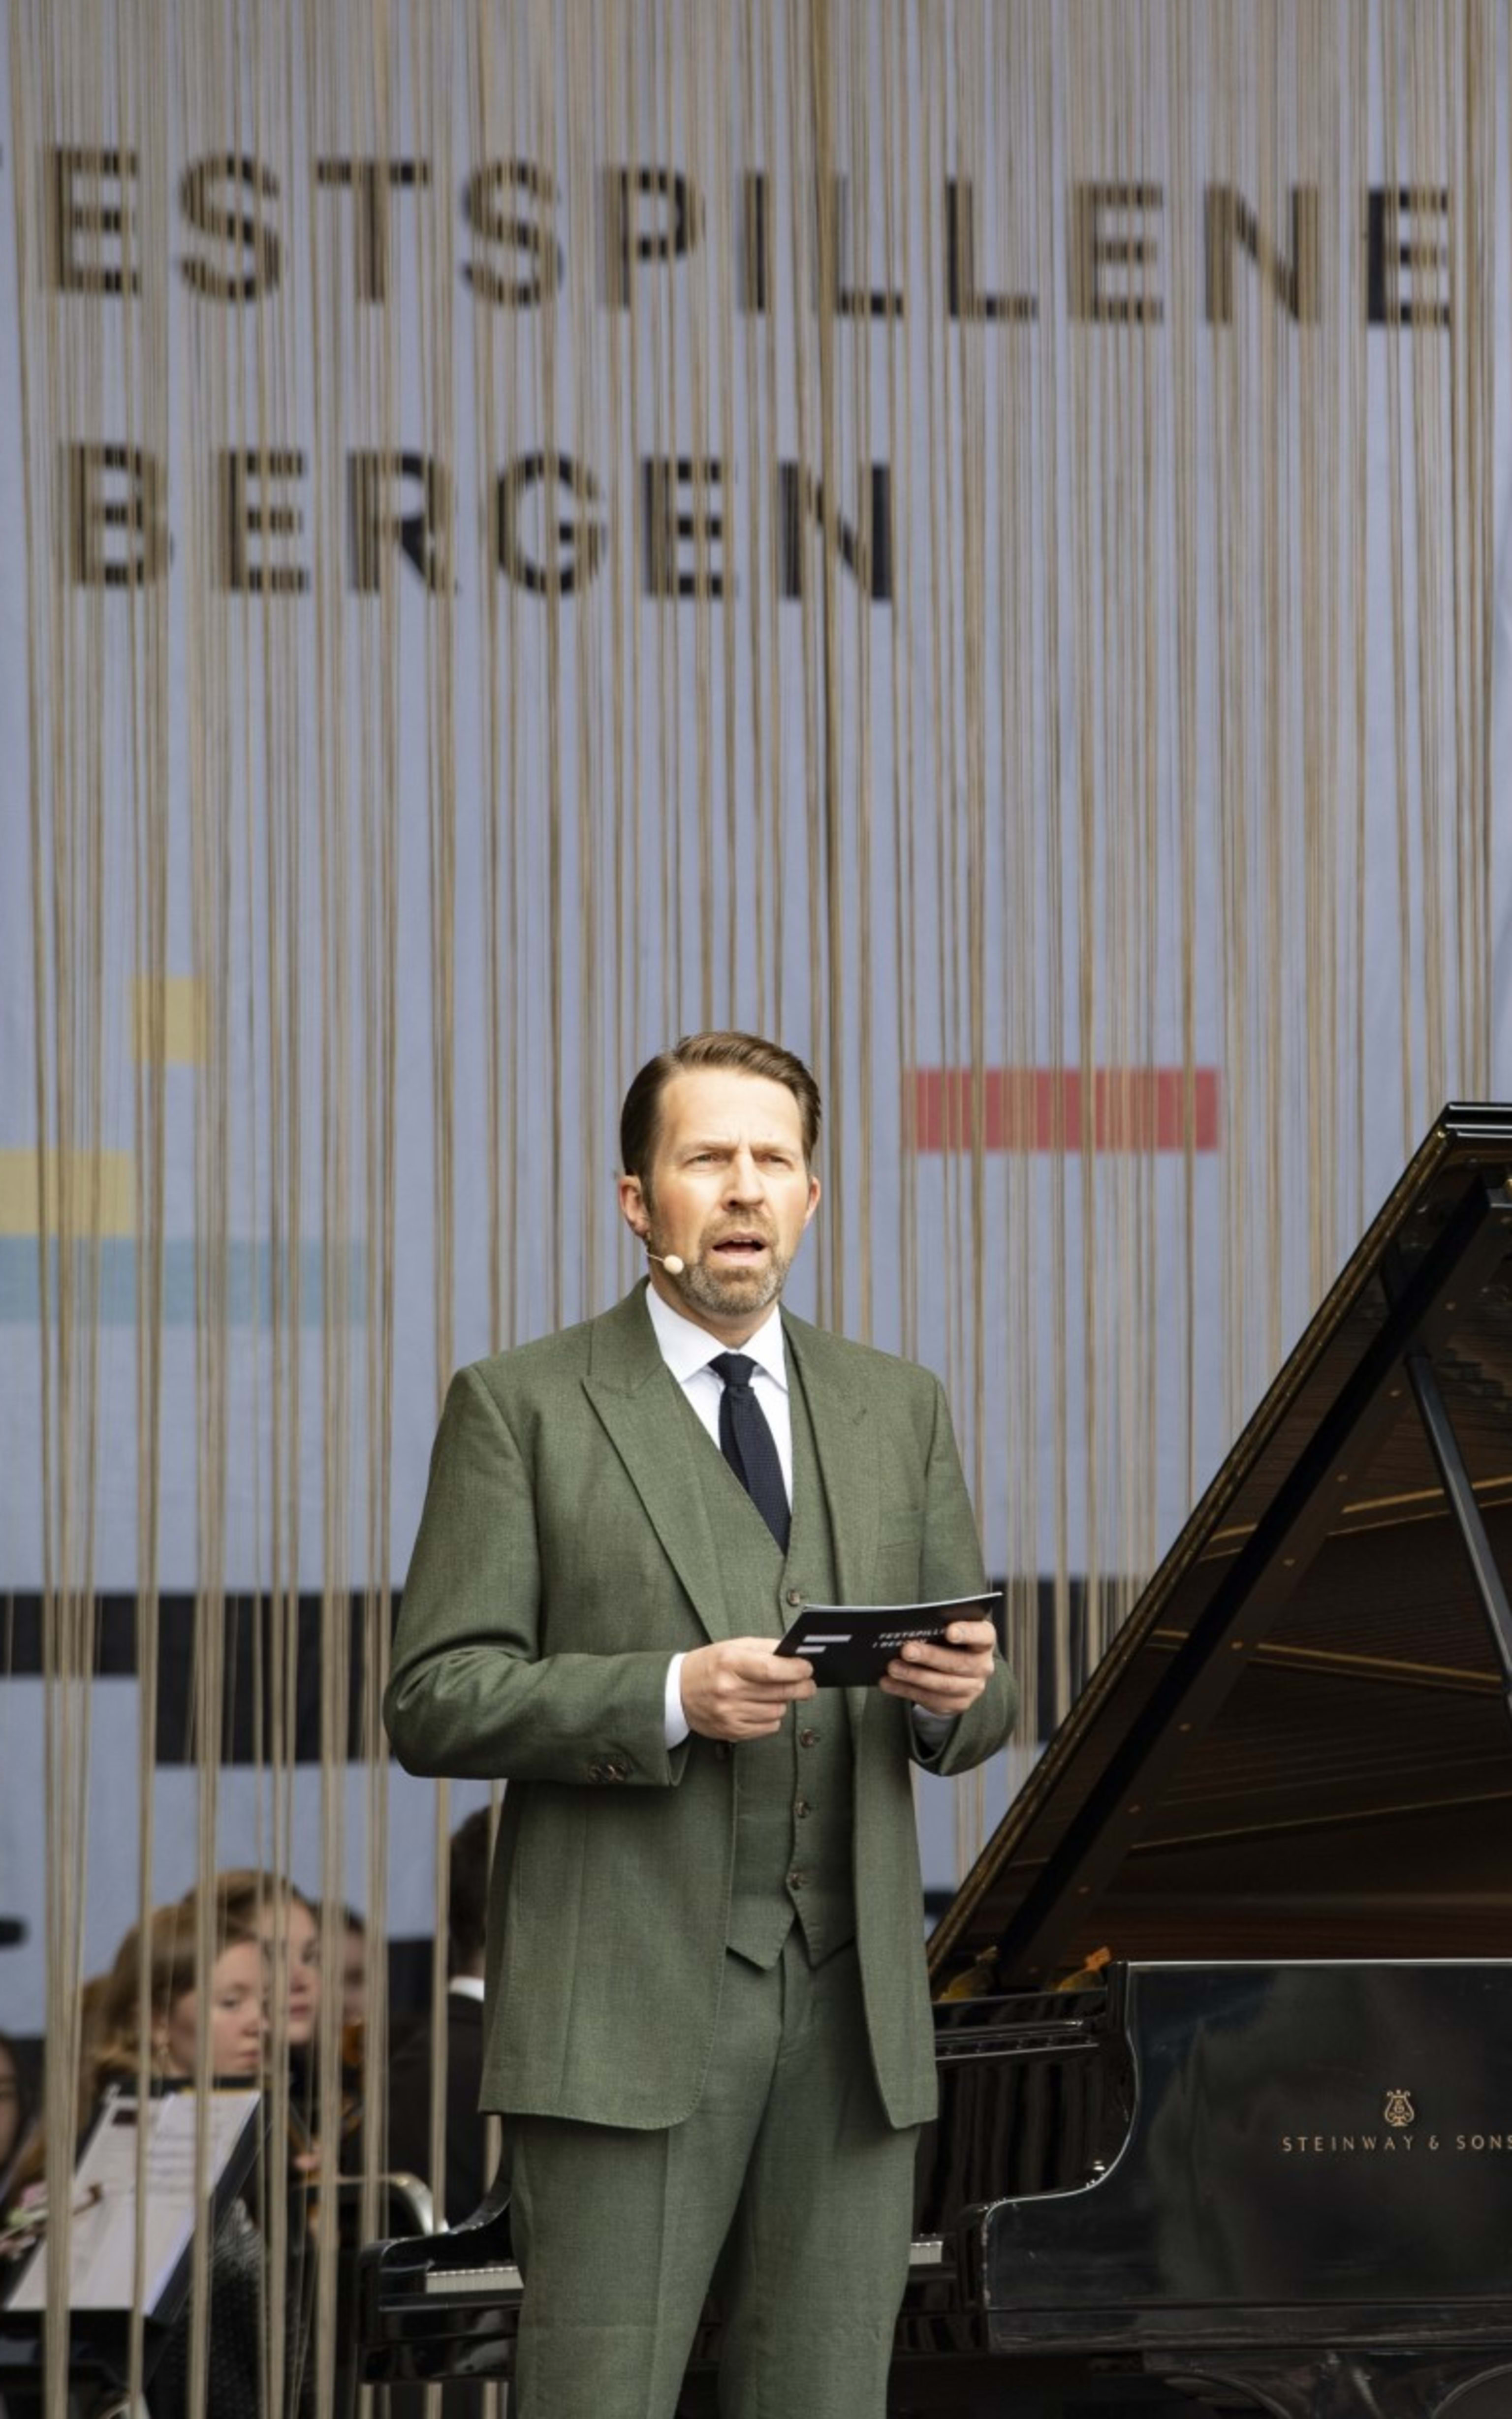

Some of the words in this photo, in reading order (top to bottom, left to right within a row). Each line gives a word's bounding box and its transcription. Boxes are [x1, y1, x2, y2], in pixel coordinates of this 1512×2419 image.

[0, 147, 1450, 327] ESTSPILLENE
[68, 441, 892, 601] BERGEN
[1282, 2135, 1414, 2152] STEINWAY
[1428, 2135, 1440, 2150] &
